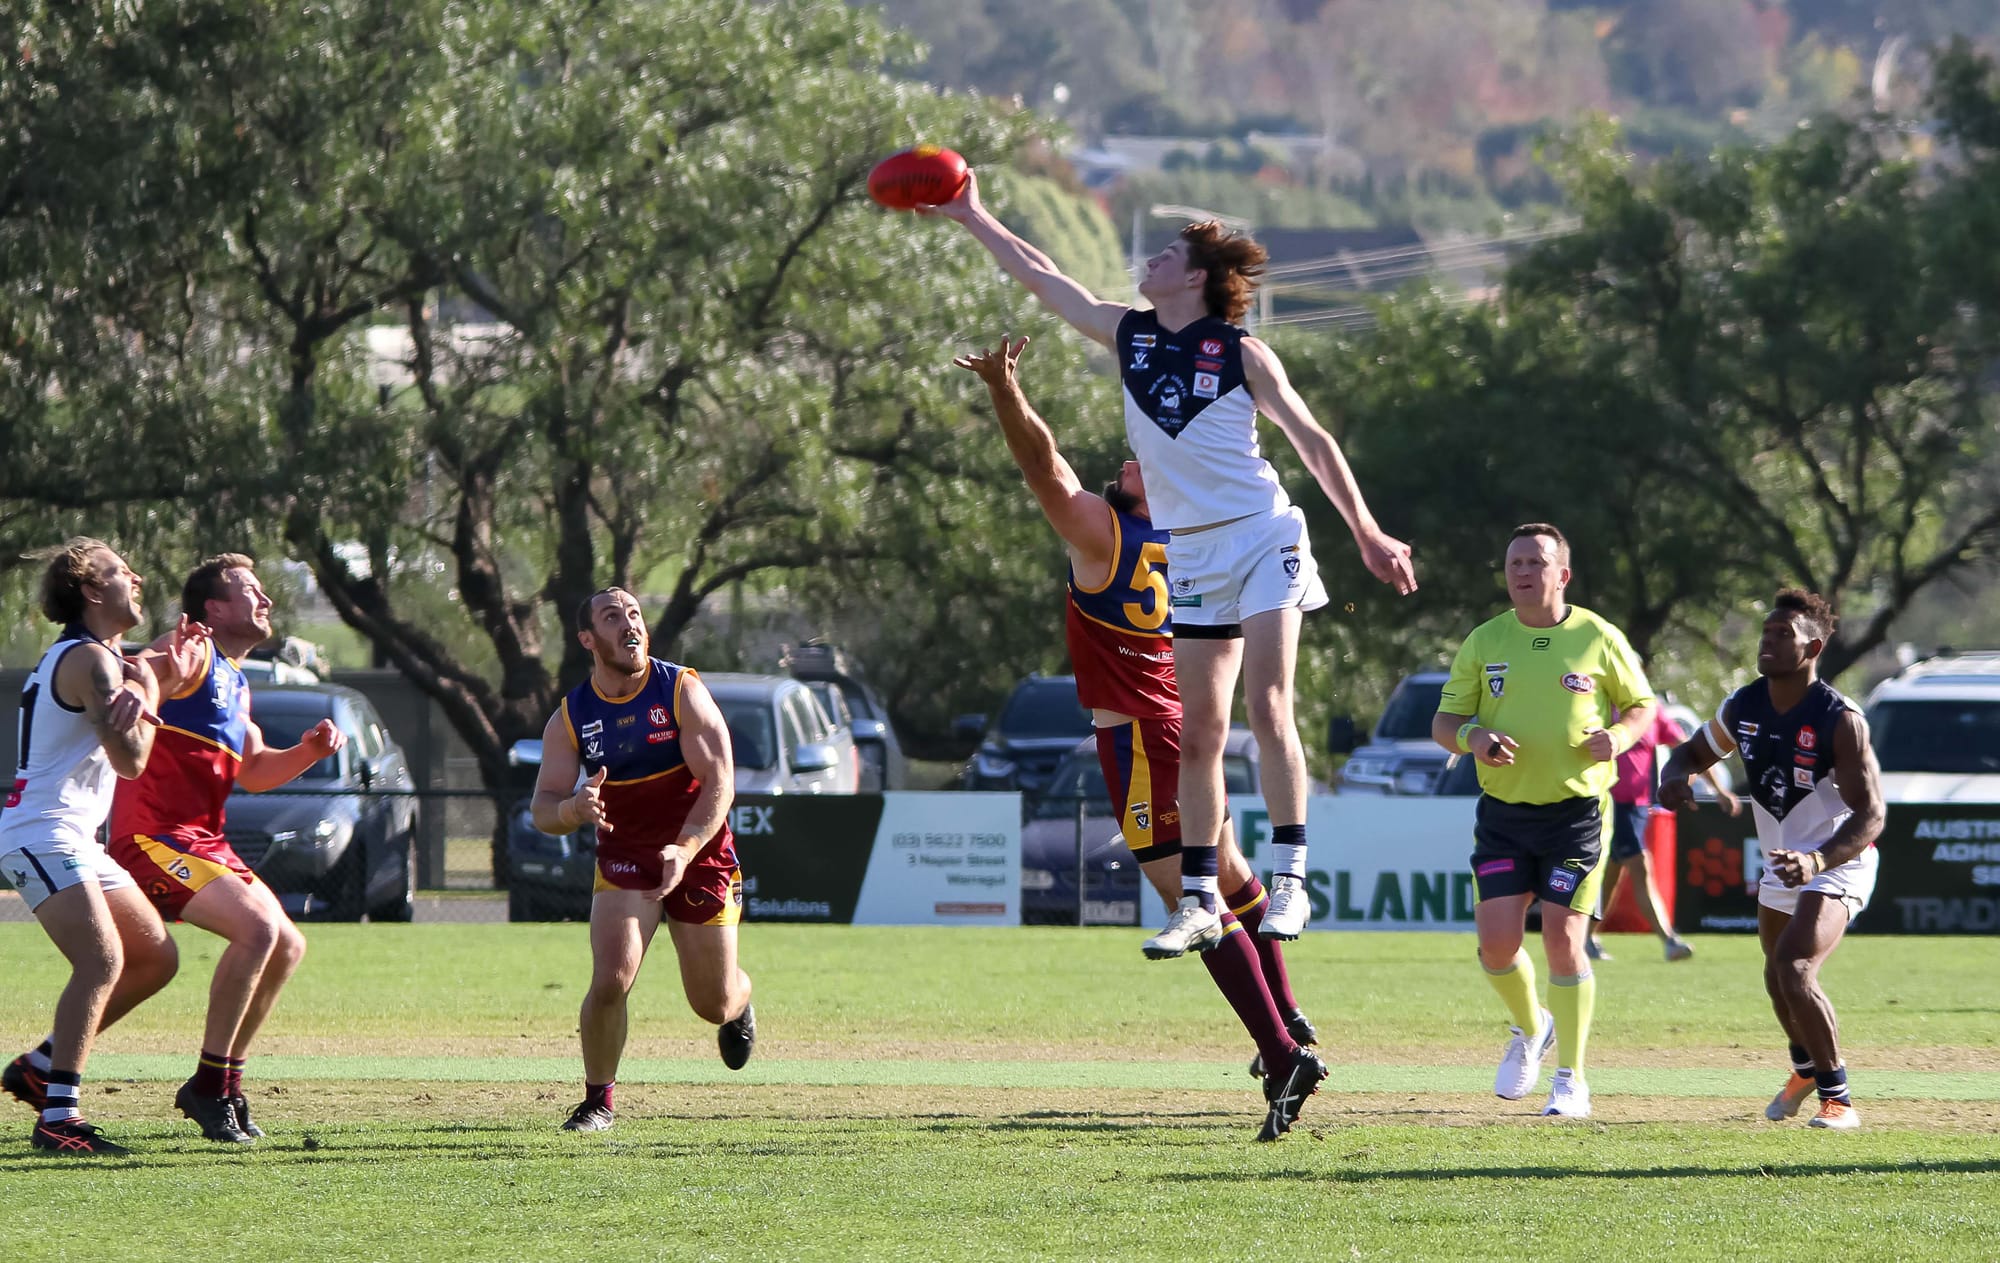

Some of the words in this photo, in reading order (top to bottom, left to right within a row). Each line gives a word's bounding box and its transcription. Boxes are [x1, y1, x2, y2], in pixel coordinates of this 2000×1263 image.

[1124, 543, 1169, 630] 5
[968, 832, 1006, 848] 7500
[908, 854, 916, 868] 3
[966, 854, 1006, 868] Street
[1550, 879, 1570, 891] AFL
[748, 898, 831, 916] Solutions
